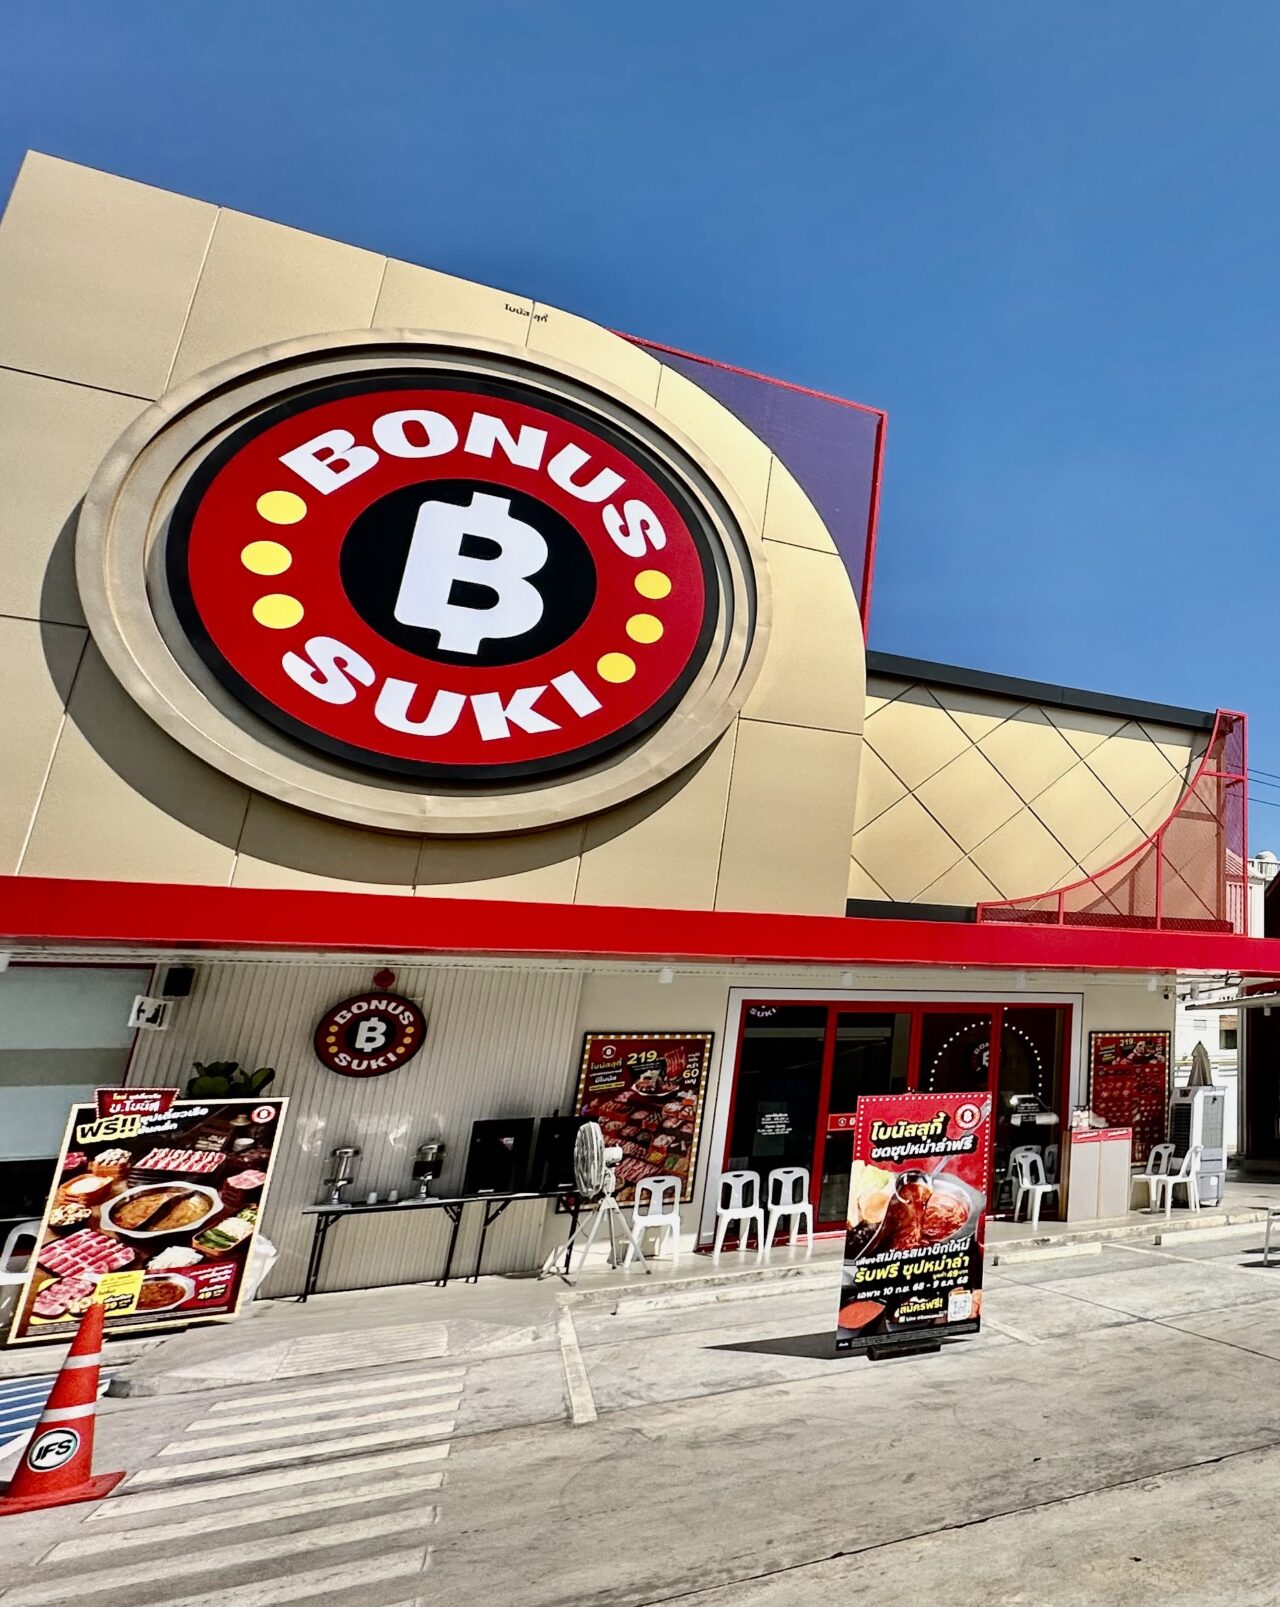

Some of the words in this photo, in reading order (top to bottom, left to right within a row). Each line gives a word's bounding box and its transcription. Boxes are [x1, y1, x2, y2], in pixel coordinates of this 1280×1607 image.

[279, 409, 666, 559] BONUS
[281, 635, 603, 741] SUKI
[333, 1000, 415, 1025] BONUS
[334, 1052, 398, 1071] SUKI
[682, 1068, 700, 1078] 60
[871, 1112, 947, 1141] โบนัสสุกี้
[854, 1260, 901, 1284] รับฟรี
[902, 1252, 970, 1280] ซุปหม่าล่า
[947, 1269, 959, 1278] 49
[882, 1286, 894, 1296] 10
[932, 1280, 940, 1289] 9
[32, 1438, 73, 1463] IFS
